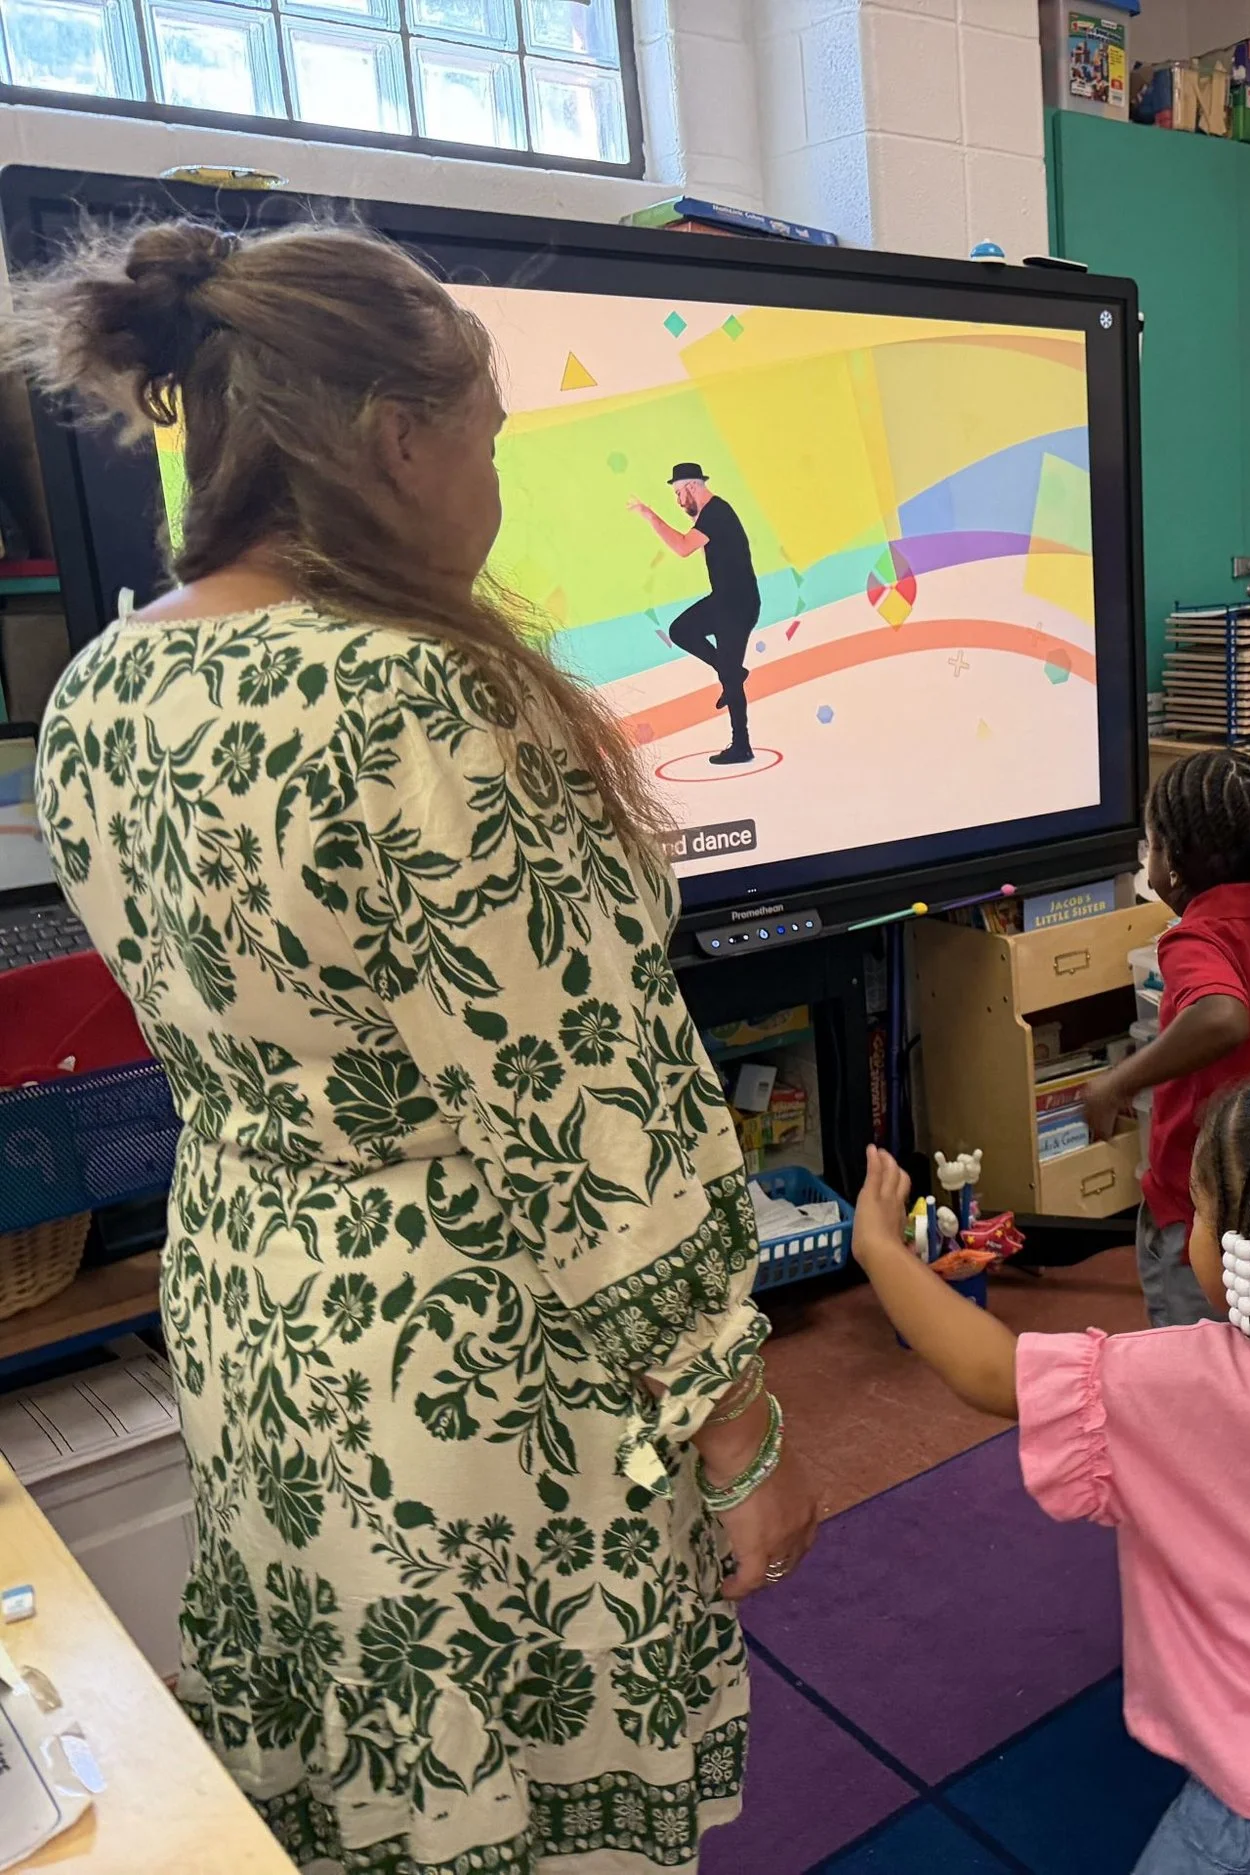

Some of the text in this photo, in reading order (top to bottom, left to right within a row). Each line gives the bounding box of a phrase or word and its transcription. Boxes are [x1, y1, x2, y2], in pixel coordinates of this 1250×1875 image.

[692, 828, 752, 852] dance
[731, 904, 784, 921] Promethean
[1035, 901, 1106, 928] LITTLE SISTER
